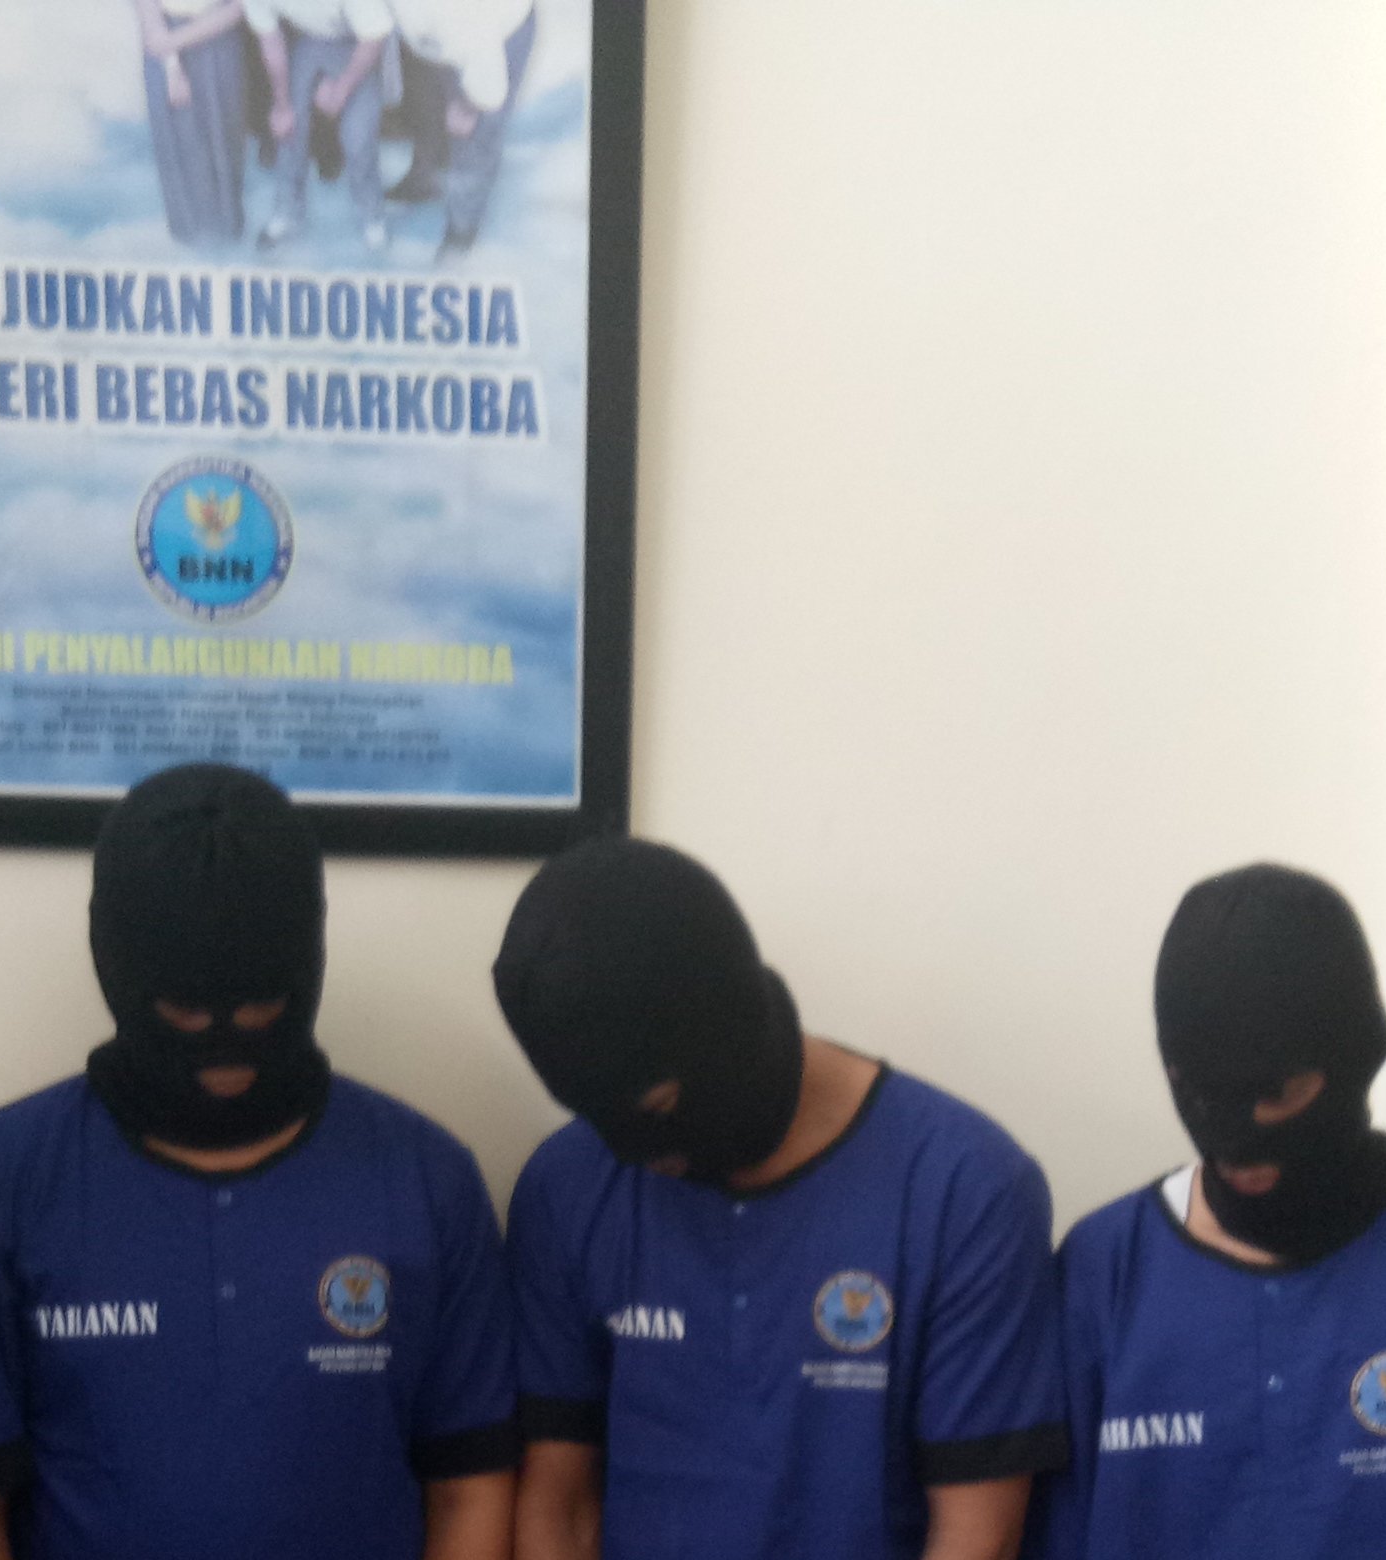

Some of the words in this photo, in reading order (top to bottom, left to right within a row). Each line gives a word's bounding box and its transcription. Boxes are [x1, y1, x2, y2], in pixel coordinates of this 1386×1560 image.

[228, 274, 519, 346] INDONESIA
[94, 363, 269, 429] BEBAS
[285, 369, 539, 438] NARKOBA
[179, 555, 255, 583] BNN
[36, 1300, 158, 1339] TAHANAN
[1099, 1409, 1205, 1453] AHANAN
